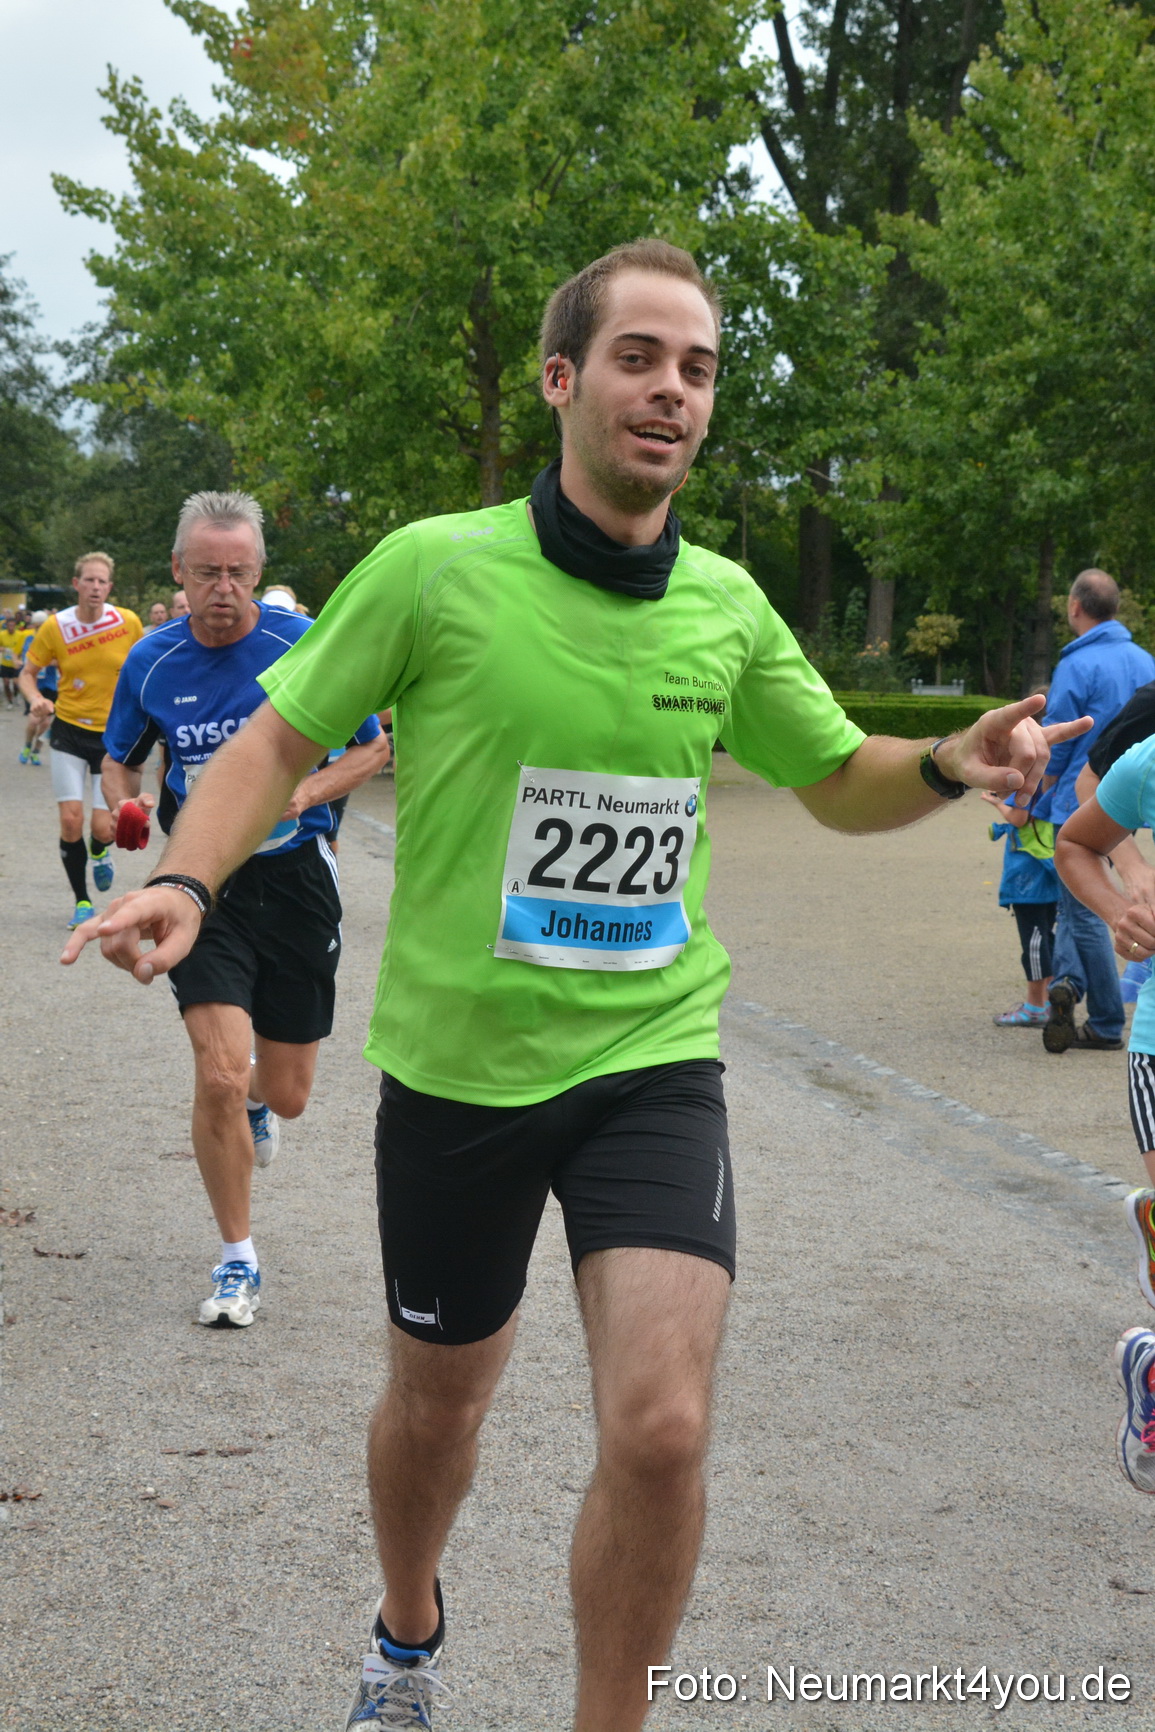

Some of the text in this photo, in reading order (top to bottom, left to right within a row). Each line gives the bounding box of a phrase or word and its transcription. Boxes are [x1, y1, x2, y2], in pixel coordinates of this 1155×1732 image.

[67, 640, 96, 656] MAX
[664, 672, 690, 686] Team
[652, 694, 694, 713] SMART
[521, 786, 680, 815] PARTL Neumarkt
[527, 817, 684, 895] 2223
[511, 880, 520, 893] A
[540, 910, 653, 943] Johannes
